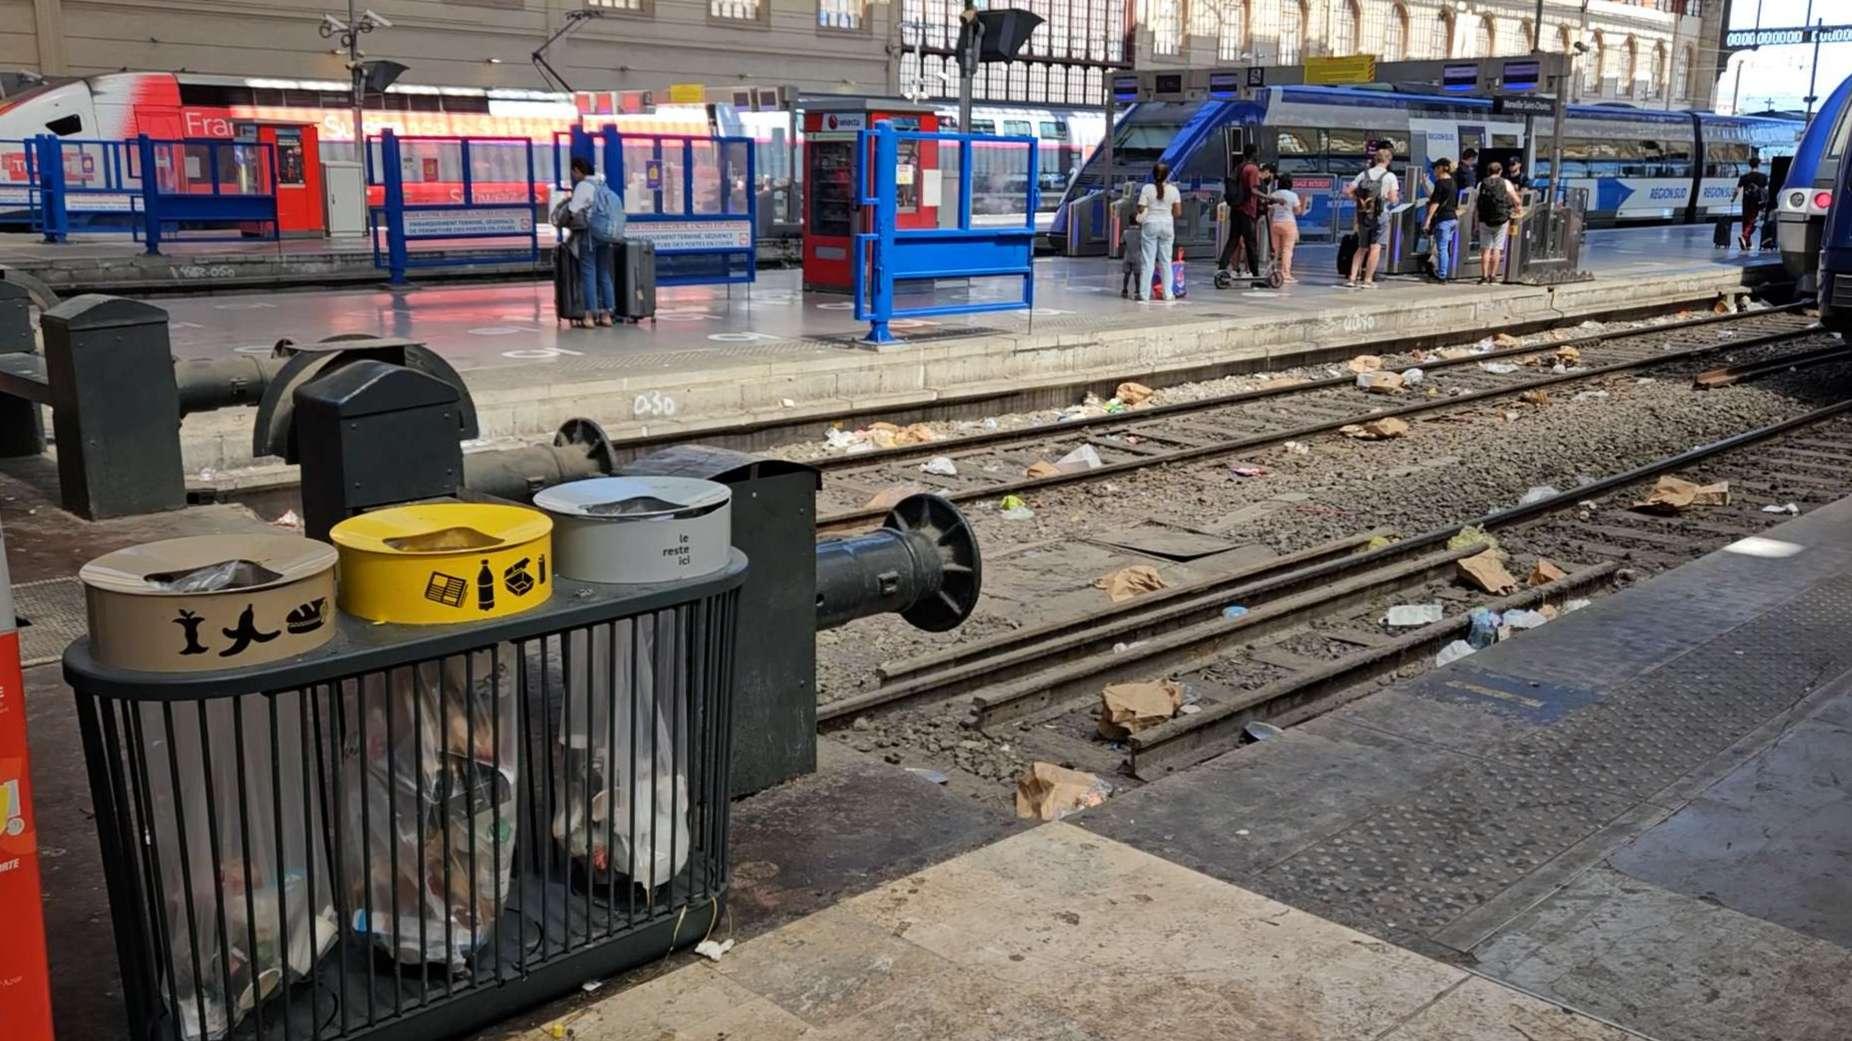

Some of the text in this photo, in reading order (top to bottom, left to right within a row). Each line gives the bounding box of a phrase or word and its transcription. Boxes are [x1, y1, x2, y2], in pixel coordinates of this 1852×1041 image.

[679, 533, 689, 544] le
[662, 546, 689, 556] reste
[678, 554, 690, 566] ici
